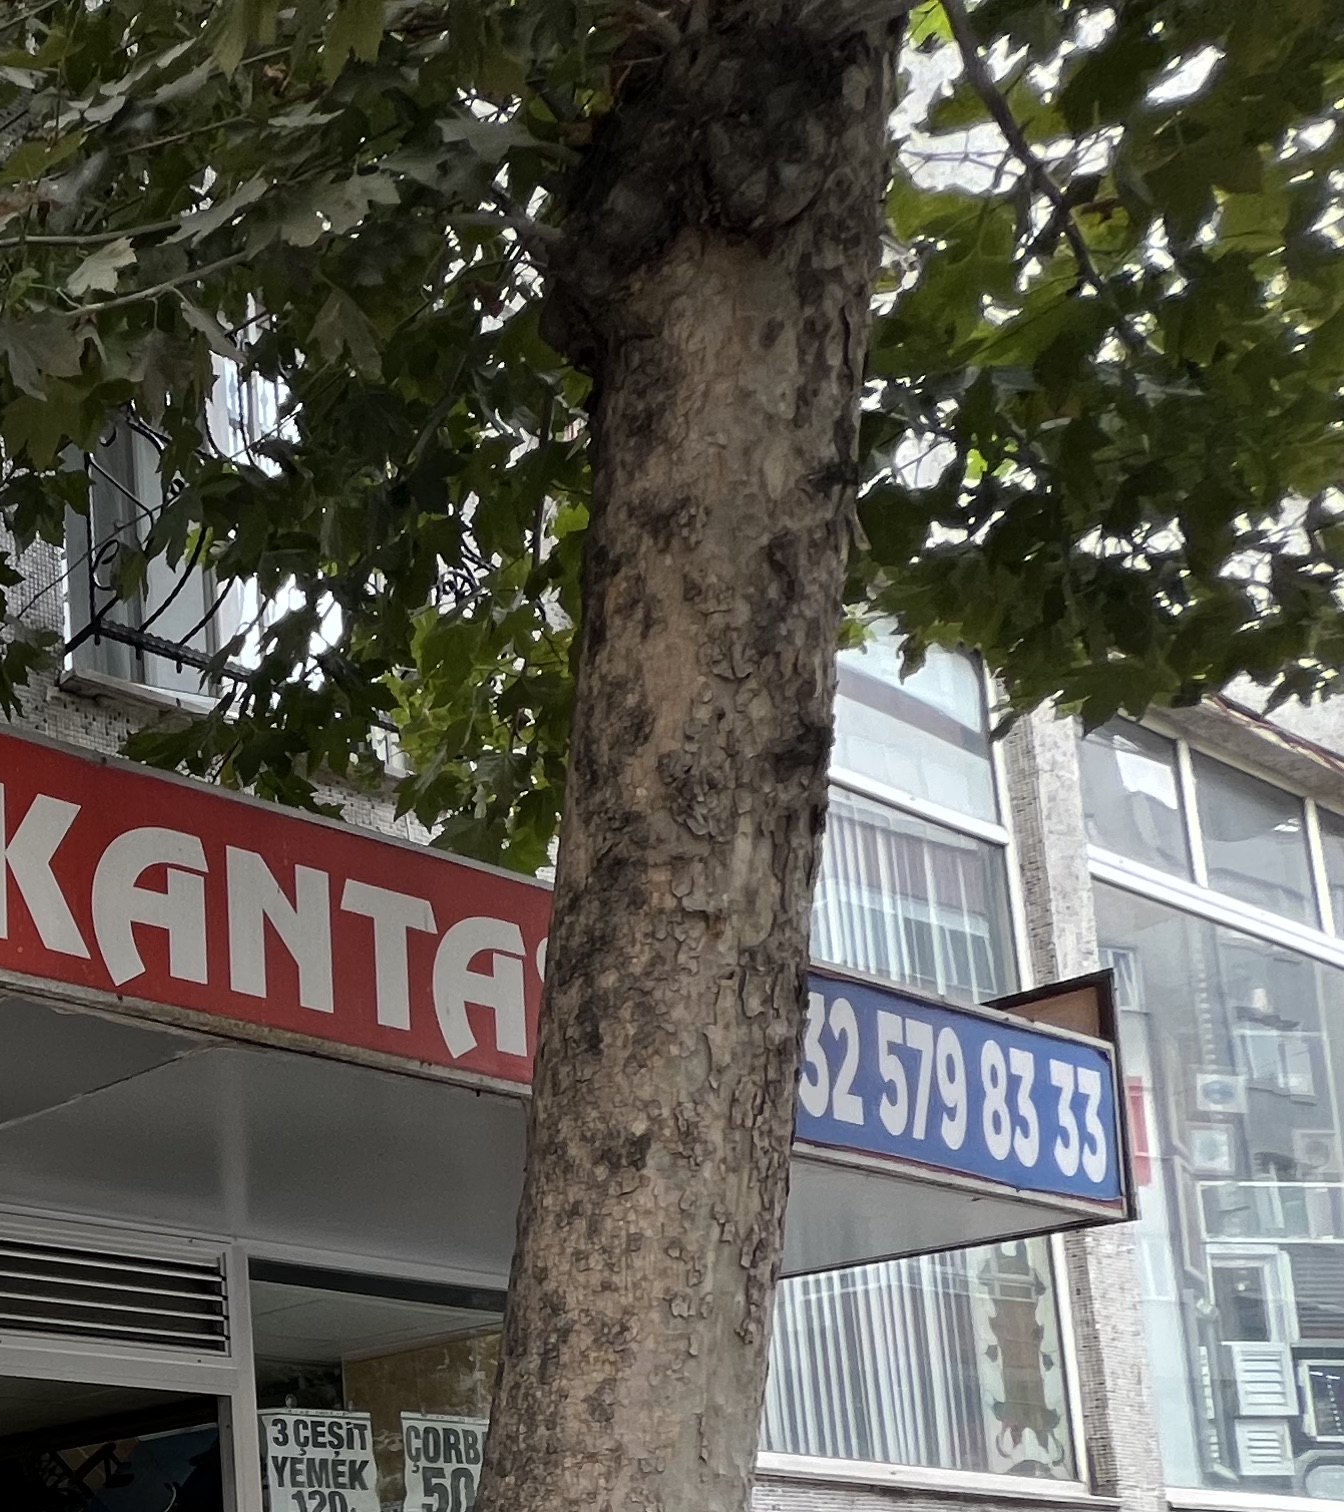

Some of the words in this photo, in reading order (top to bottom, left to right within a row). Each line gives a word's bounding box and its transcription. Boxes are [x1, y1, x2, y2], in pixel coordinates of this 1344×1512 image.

[877, 1009, 968, 1151] 579
[980, 1039, 1040, 1168] 83
[1049, 1058, 1107, 1184] 33
[271, 1418, 289, 1447] 3
[405, 1425, 488, 1474] ÇORB
[271, 1455, 370, 1491] YEMEK
